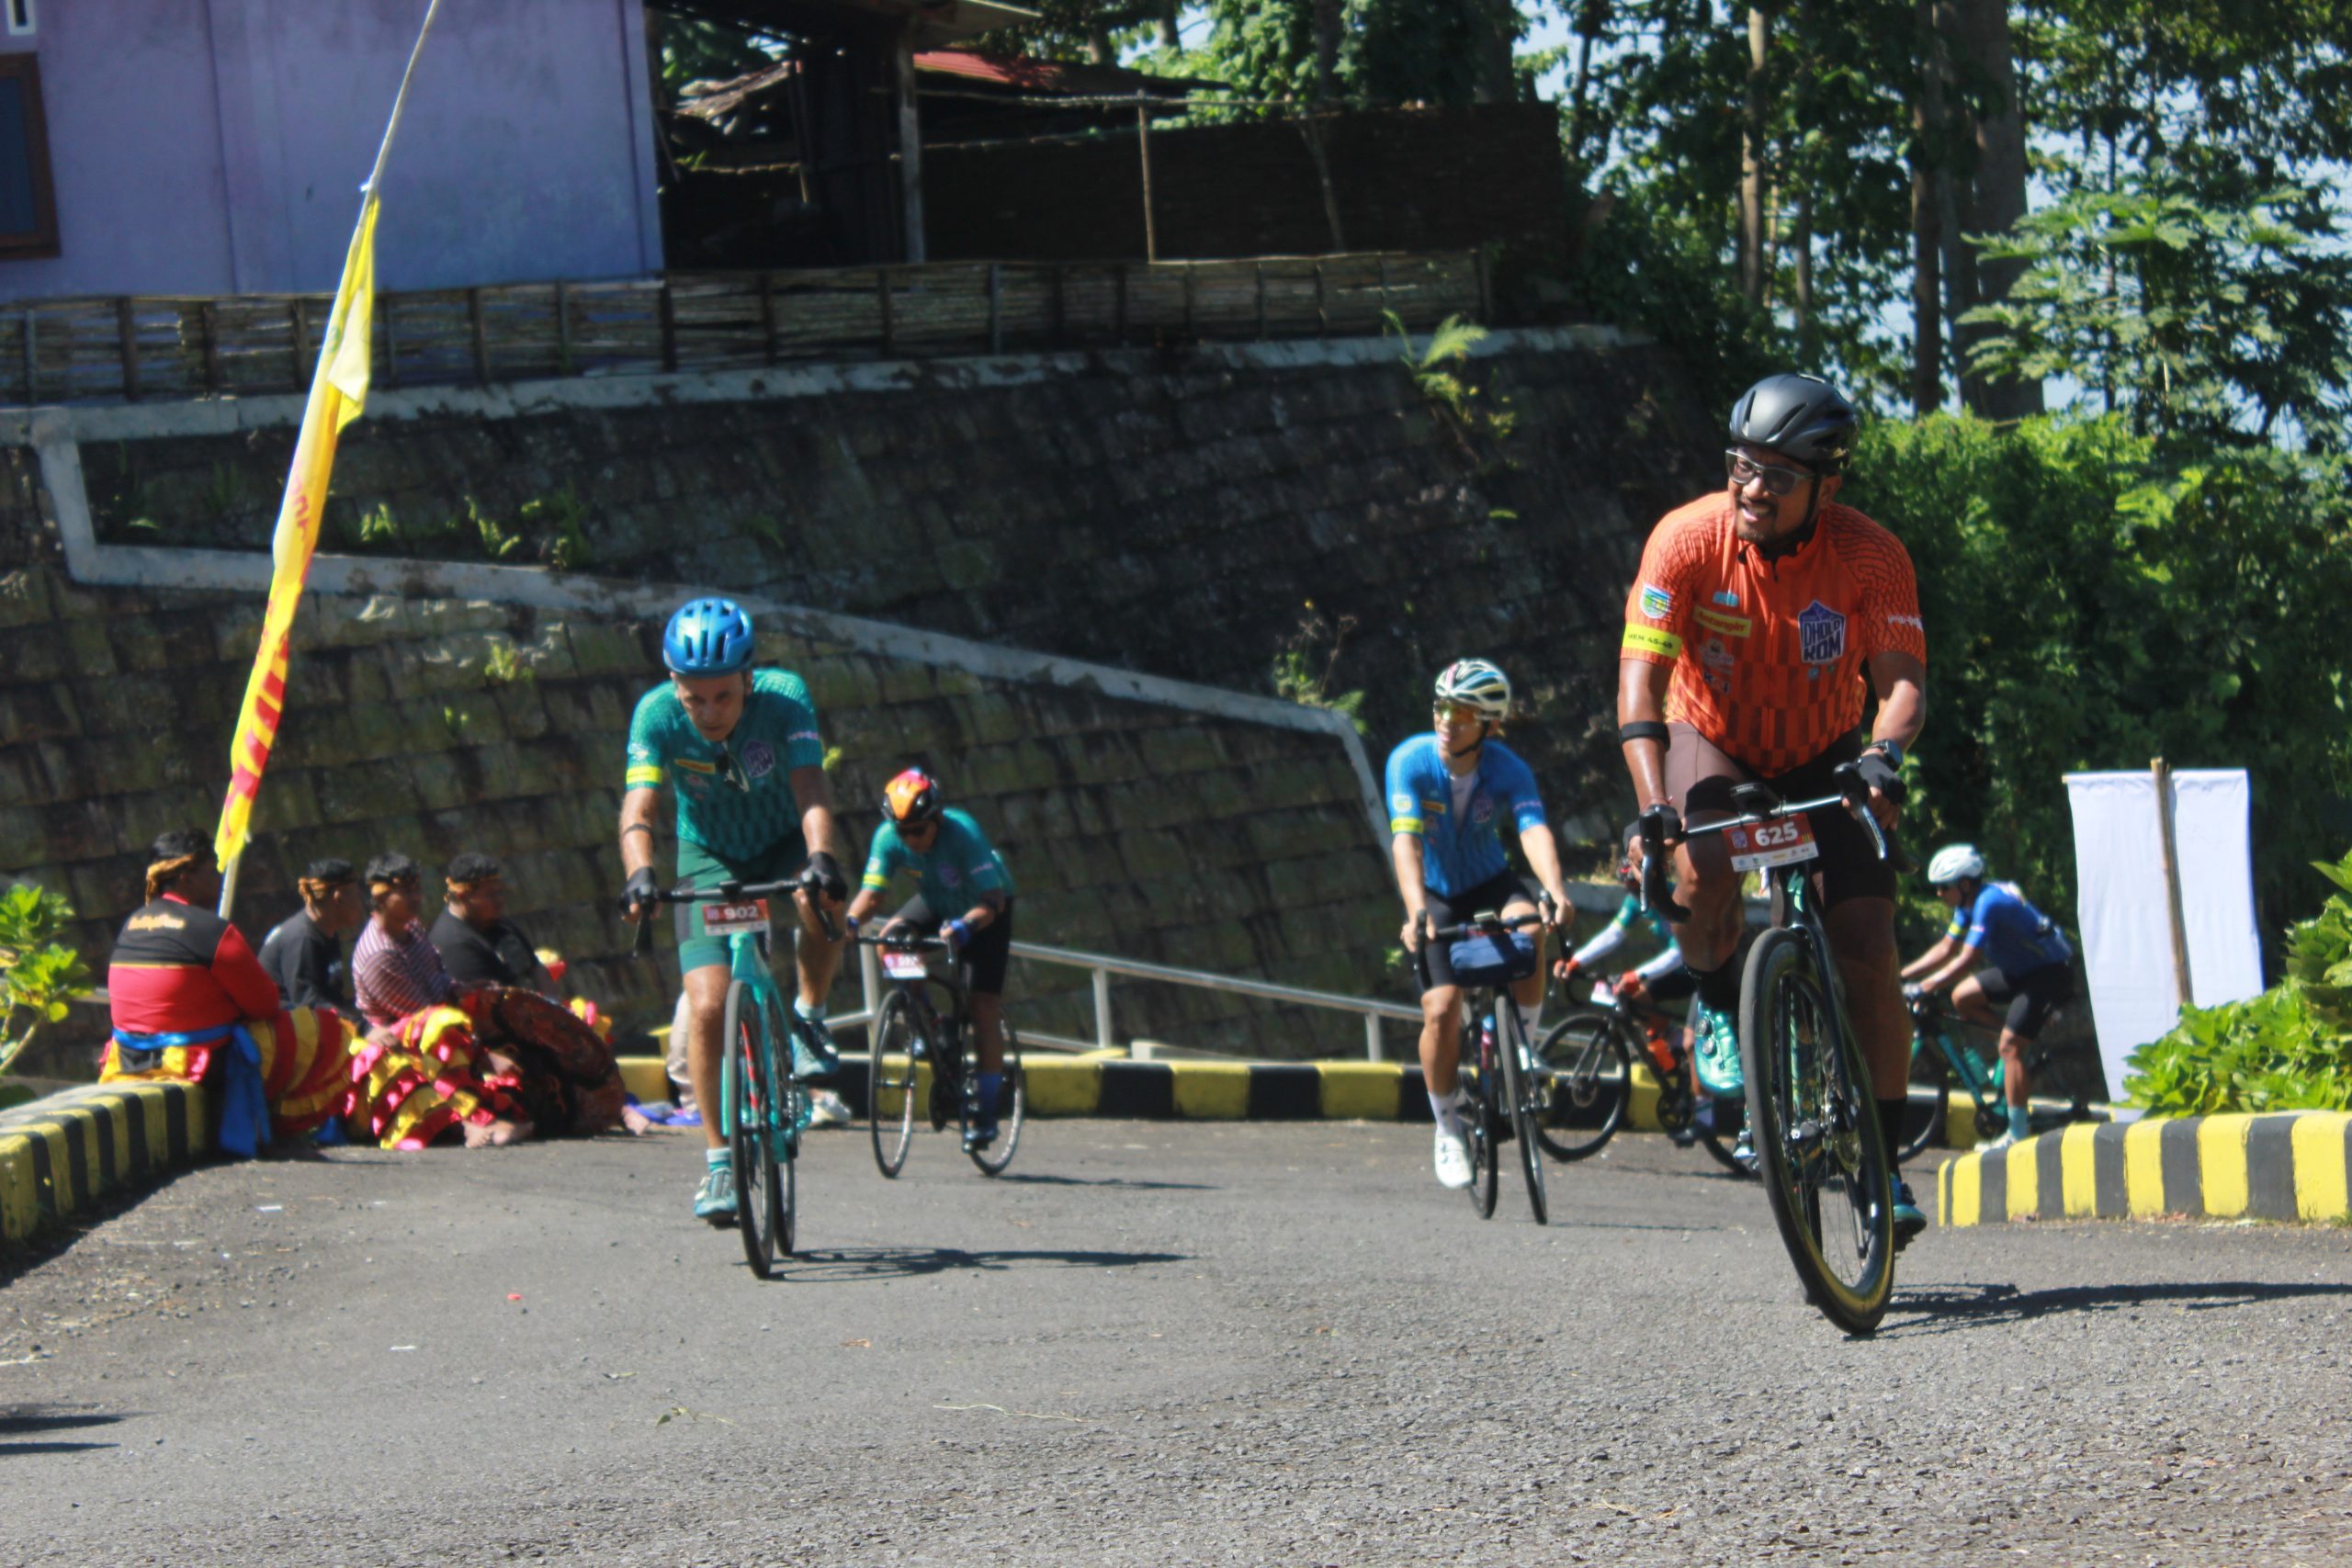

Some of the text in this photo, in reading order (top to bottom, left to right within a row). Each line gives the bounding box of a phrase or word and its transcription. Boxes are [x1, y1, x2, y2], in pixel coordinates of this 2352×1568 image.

[1803, 630, 1842, 660] KOM
[1754, 821, 1798, 846] 625
[724, 905, 758, 919] 902
